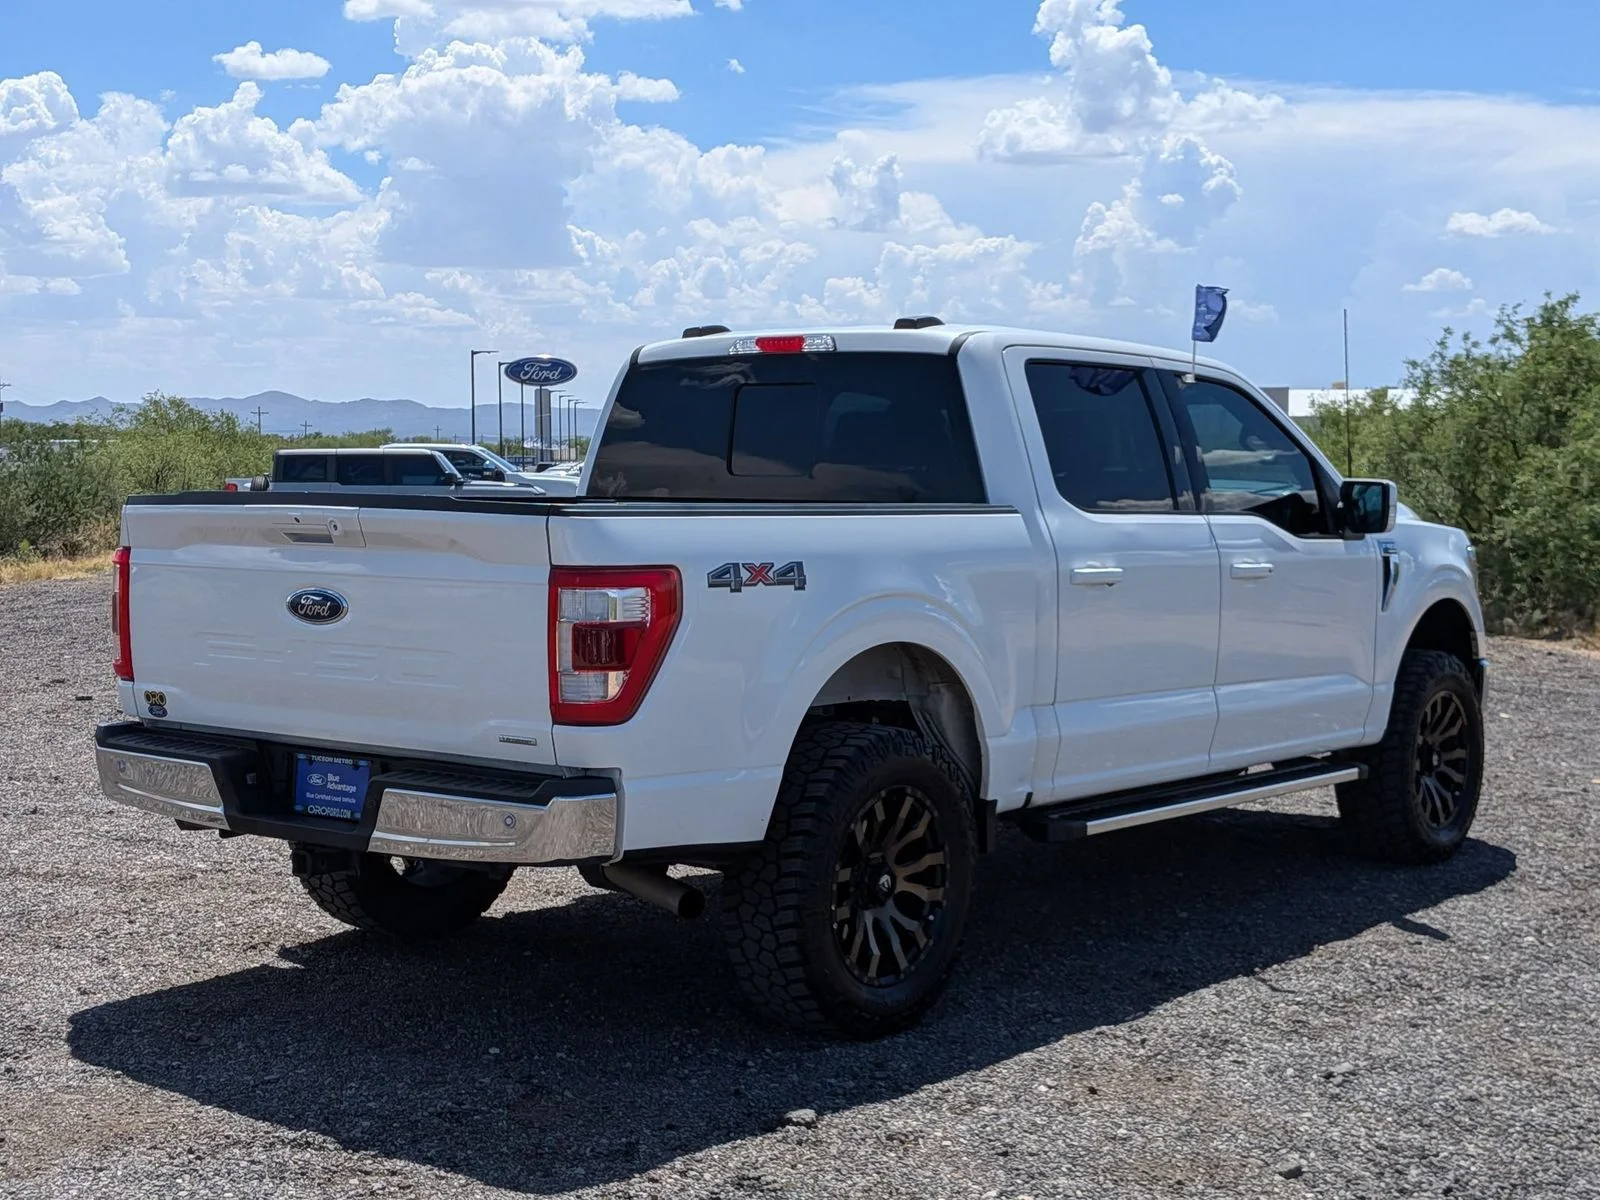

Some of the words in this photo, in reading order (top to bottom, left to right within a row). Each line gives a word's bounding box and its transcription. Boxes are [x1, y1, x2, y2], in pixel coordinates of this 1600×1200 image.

[520, 362, 562, 381] Ford
[297, 594, 331, 616] Ford
[144, 691, 166, 706] ORO
[327, 773, 340, 782] Blue
[327, 782, 356, 793] Advantage
